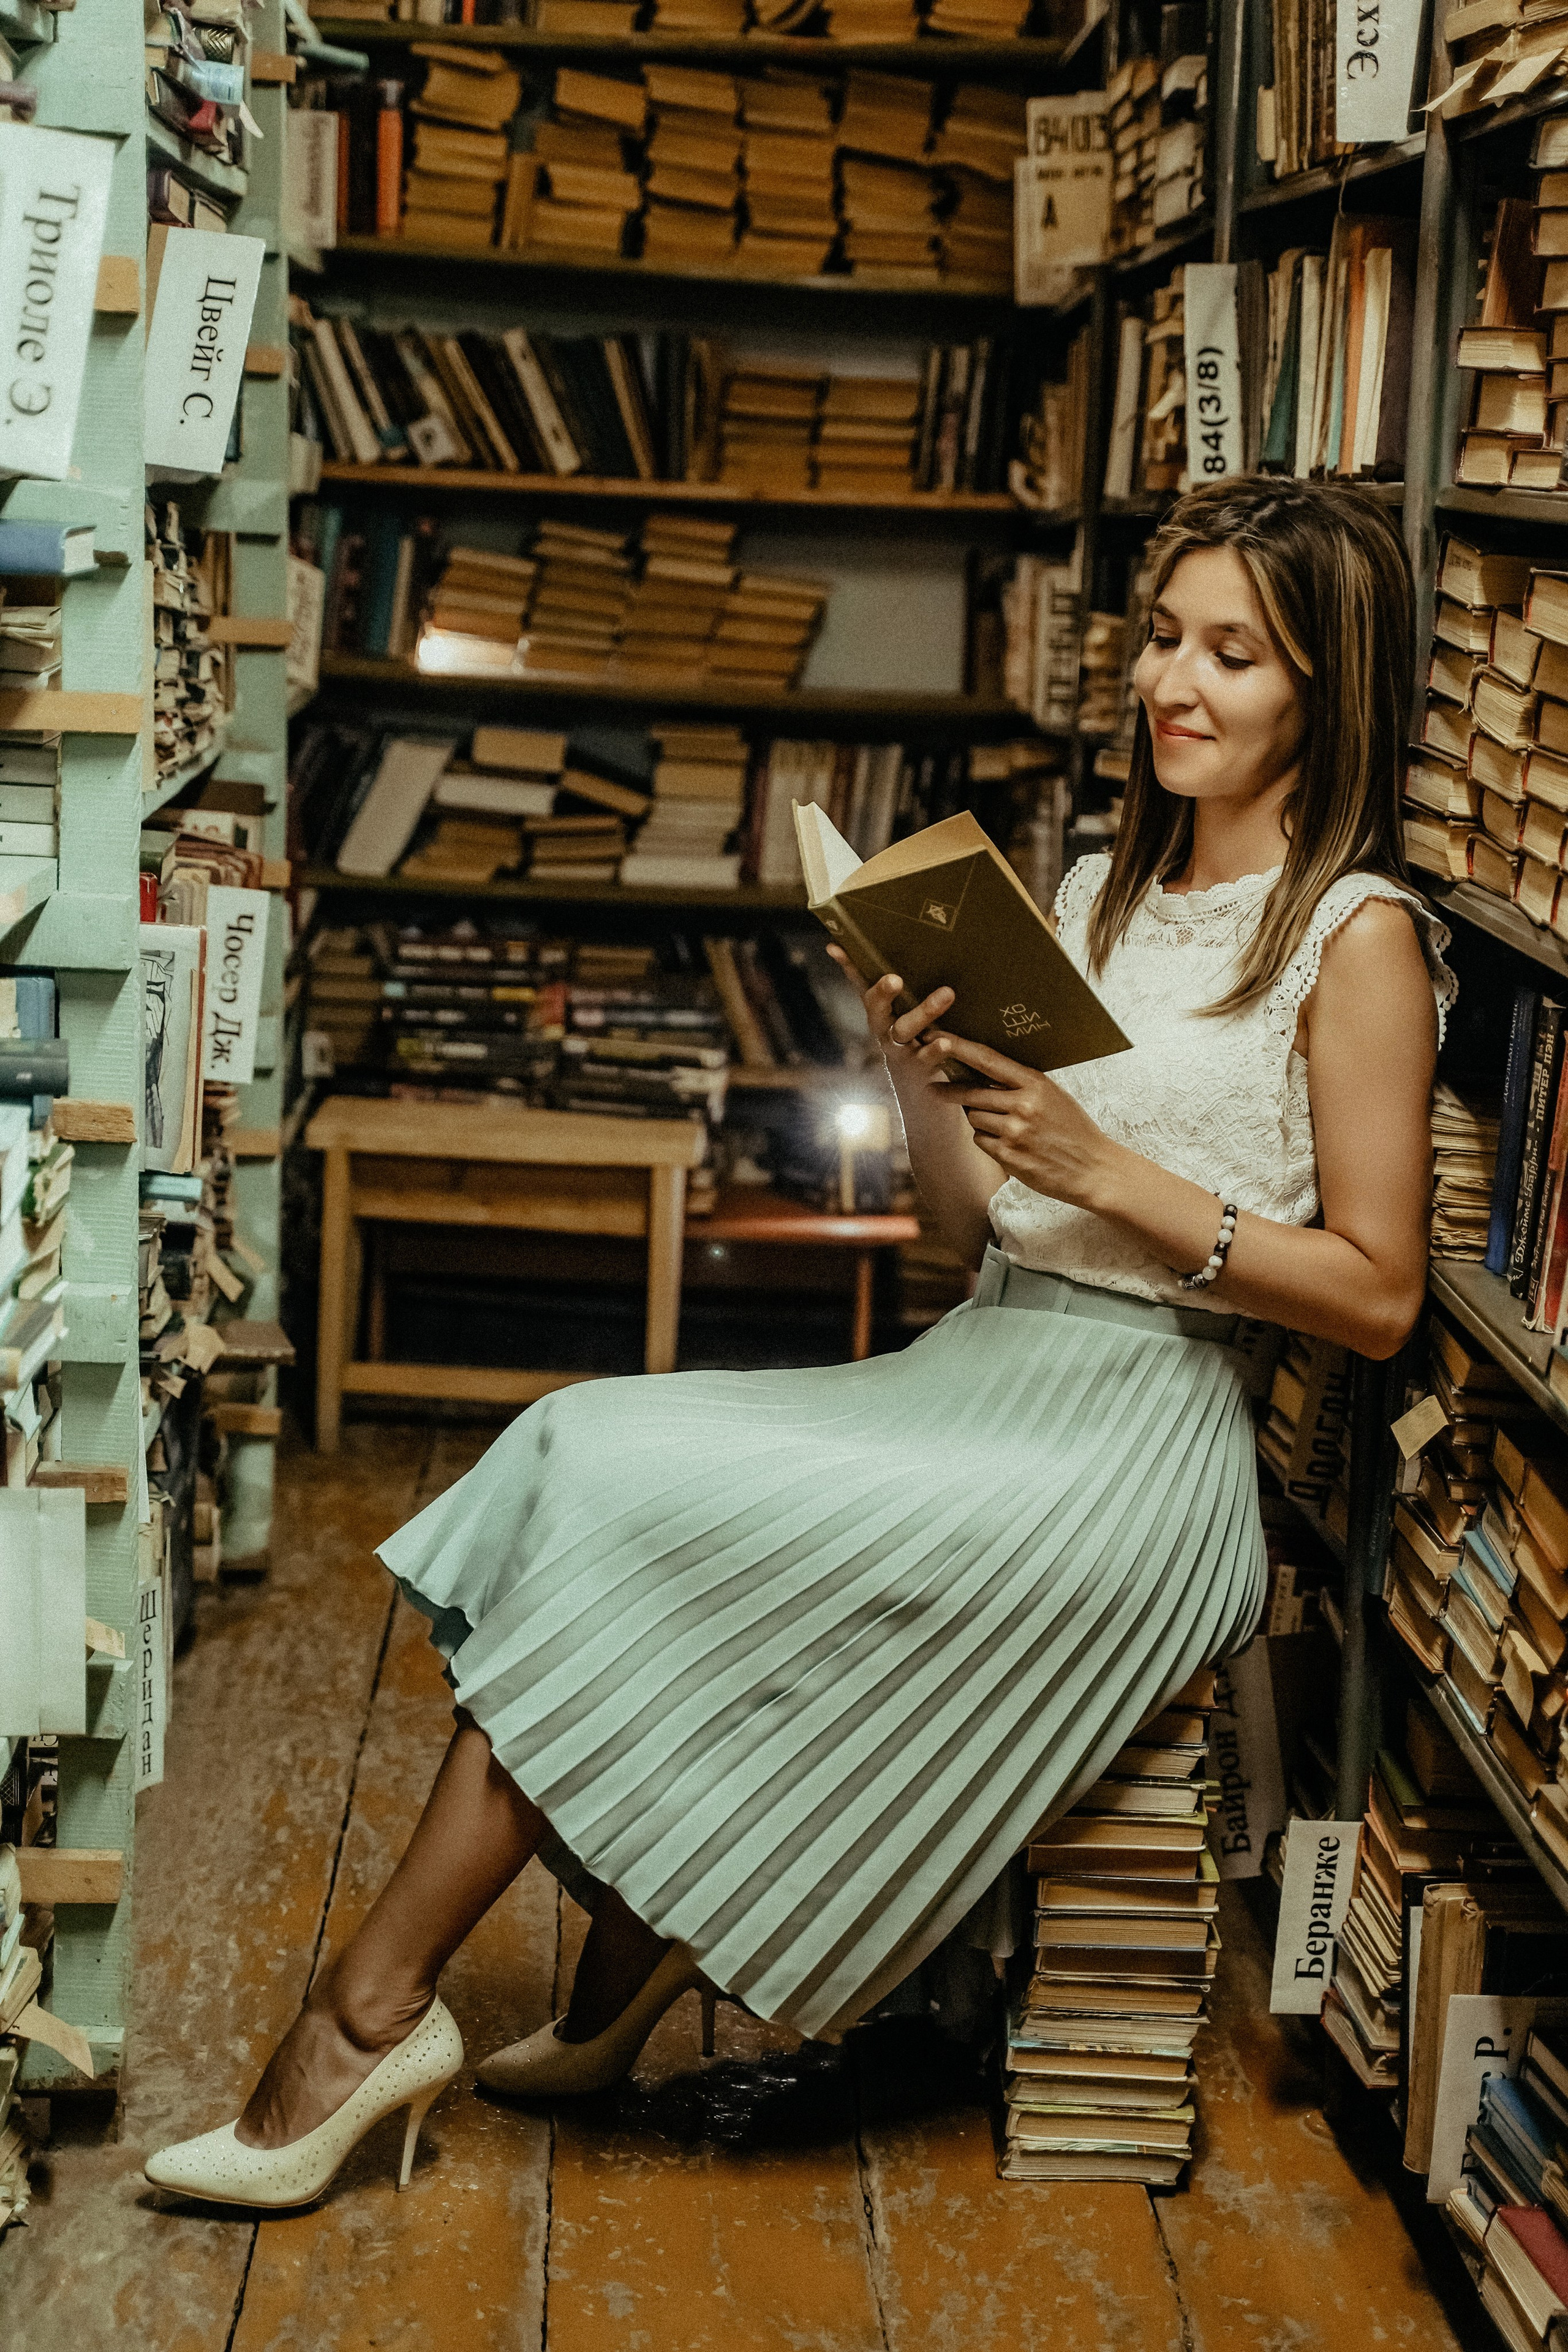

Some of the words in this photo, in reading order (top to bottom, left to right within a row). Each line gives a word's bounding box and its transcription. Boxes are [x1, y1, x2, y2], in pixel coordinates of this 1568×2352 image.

[17, 185, 81, 364] Триоле
[190, 274, 237, 381] Цвейг
[5, 377, 52, 426] Э.
[179, 392, 214, 425] С.
[1197, 347, 1229, 473] 84(3/8)
[217, 914, 255, 1003] Чосер
[211, 1012, 242, 1069] Дж.
[1000, 1003, 1027, 1017] ХО
[1002, 1011, 1041, 1028] ШИ
[1006, 1020, 1051, 1038] МИН
[1515, 1200, 1531, 1263] Джеймс
[1536, 1068, 1550, 1121] ПИТЕР
[1544, 1033, 1555, 1065] ПЭН
[140, 1589, 157, 1776] Шеридан
[1214, 1728, 1251, 1856] Байрон
[1294, 1835, 1341, 1981] Беранже
[1474, 2027, 1512, 2061] Р.
